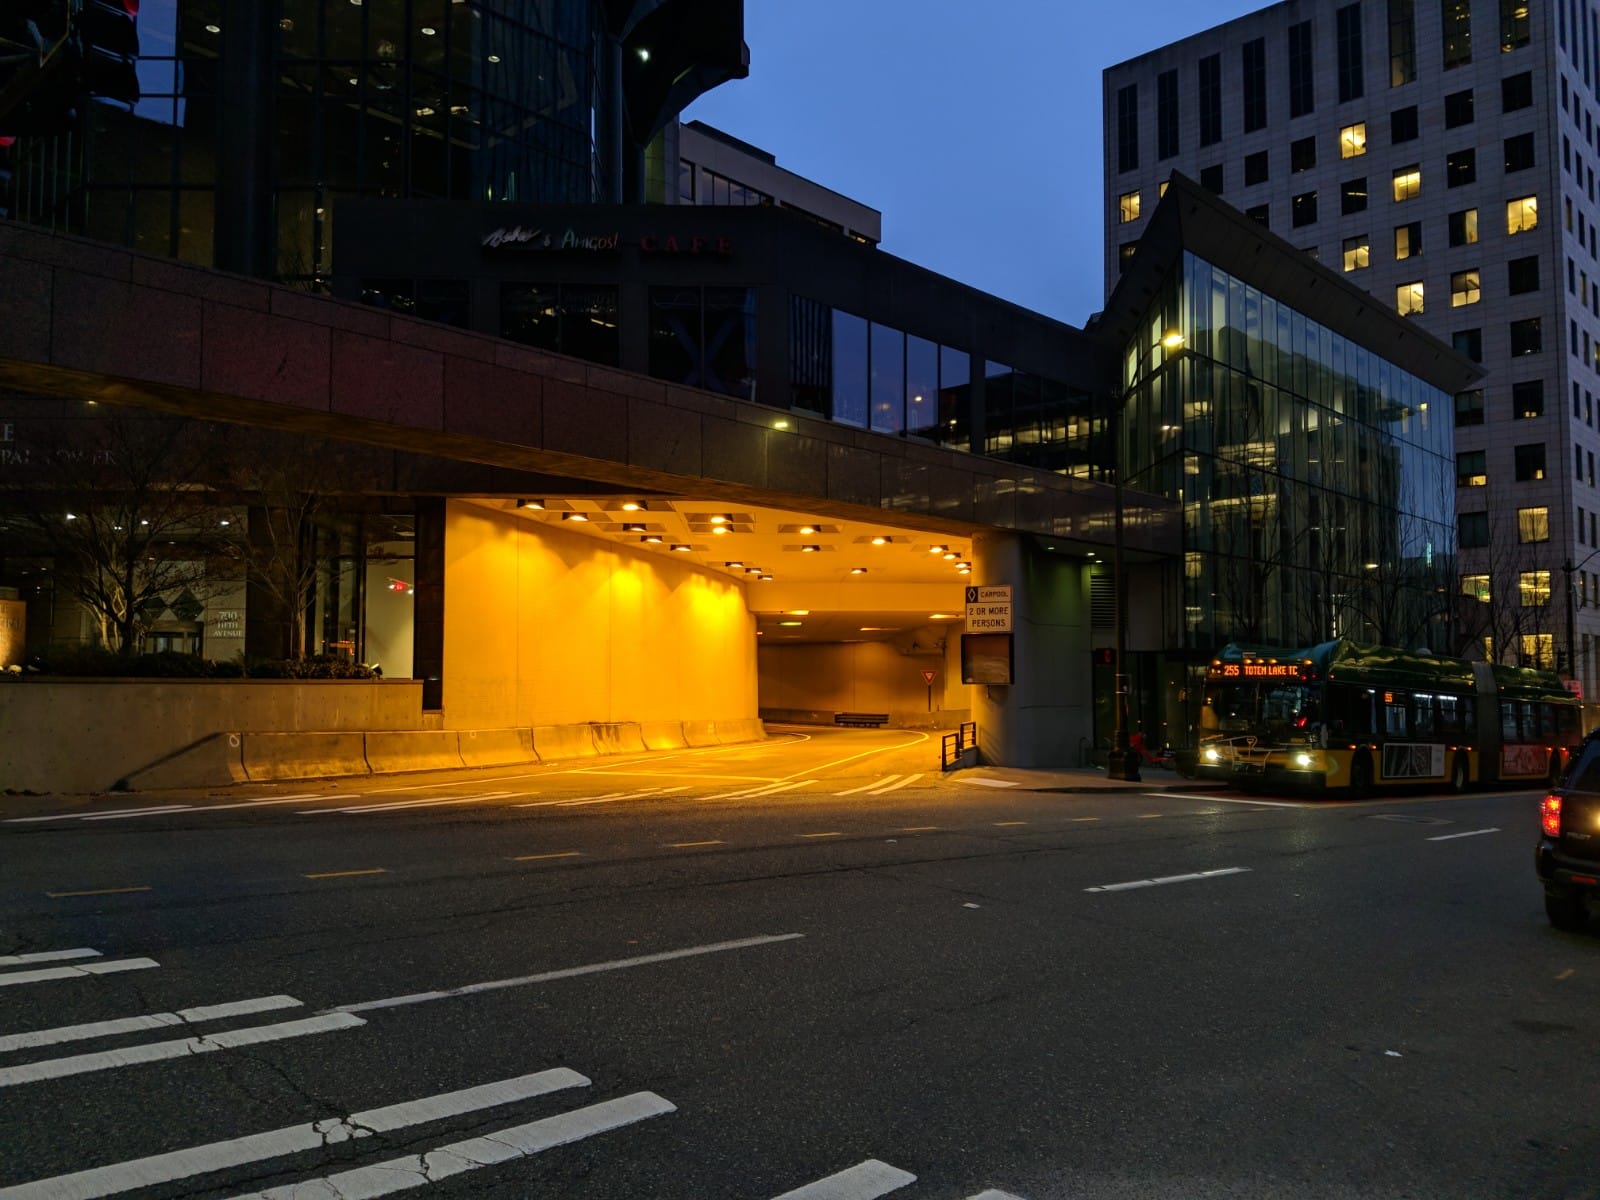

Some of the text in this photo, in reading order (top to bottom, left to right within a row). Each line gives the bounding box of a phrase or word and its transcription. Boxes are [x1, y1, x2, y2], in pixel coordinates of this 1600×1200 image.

[640, 234, 736, 255] CAFE
[969, 606, 1009, 616] 2 OR MORE
[972, 619, 1006, 628] PERSONS
[1224, 665, 1299, 676] 255 TOTEM LAKE TC
